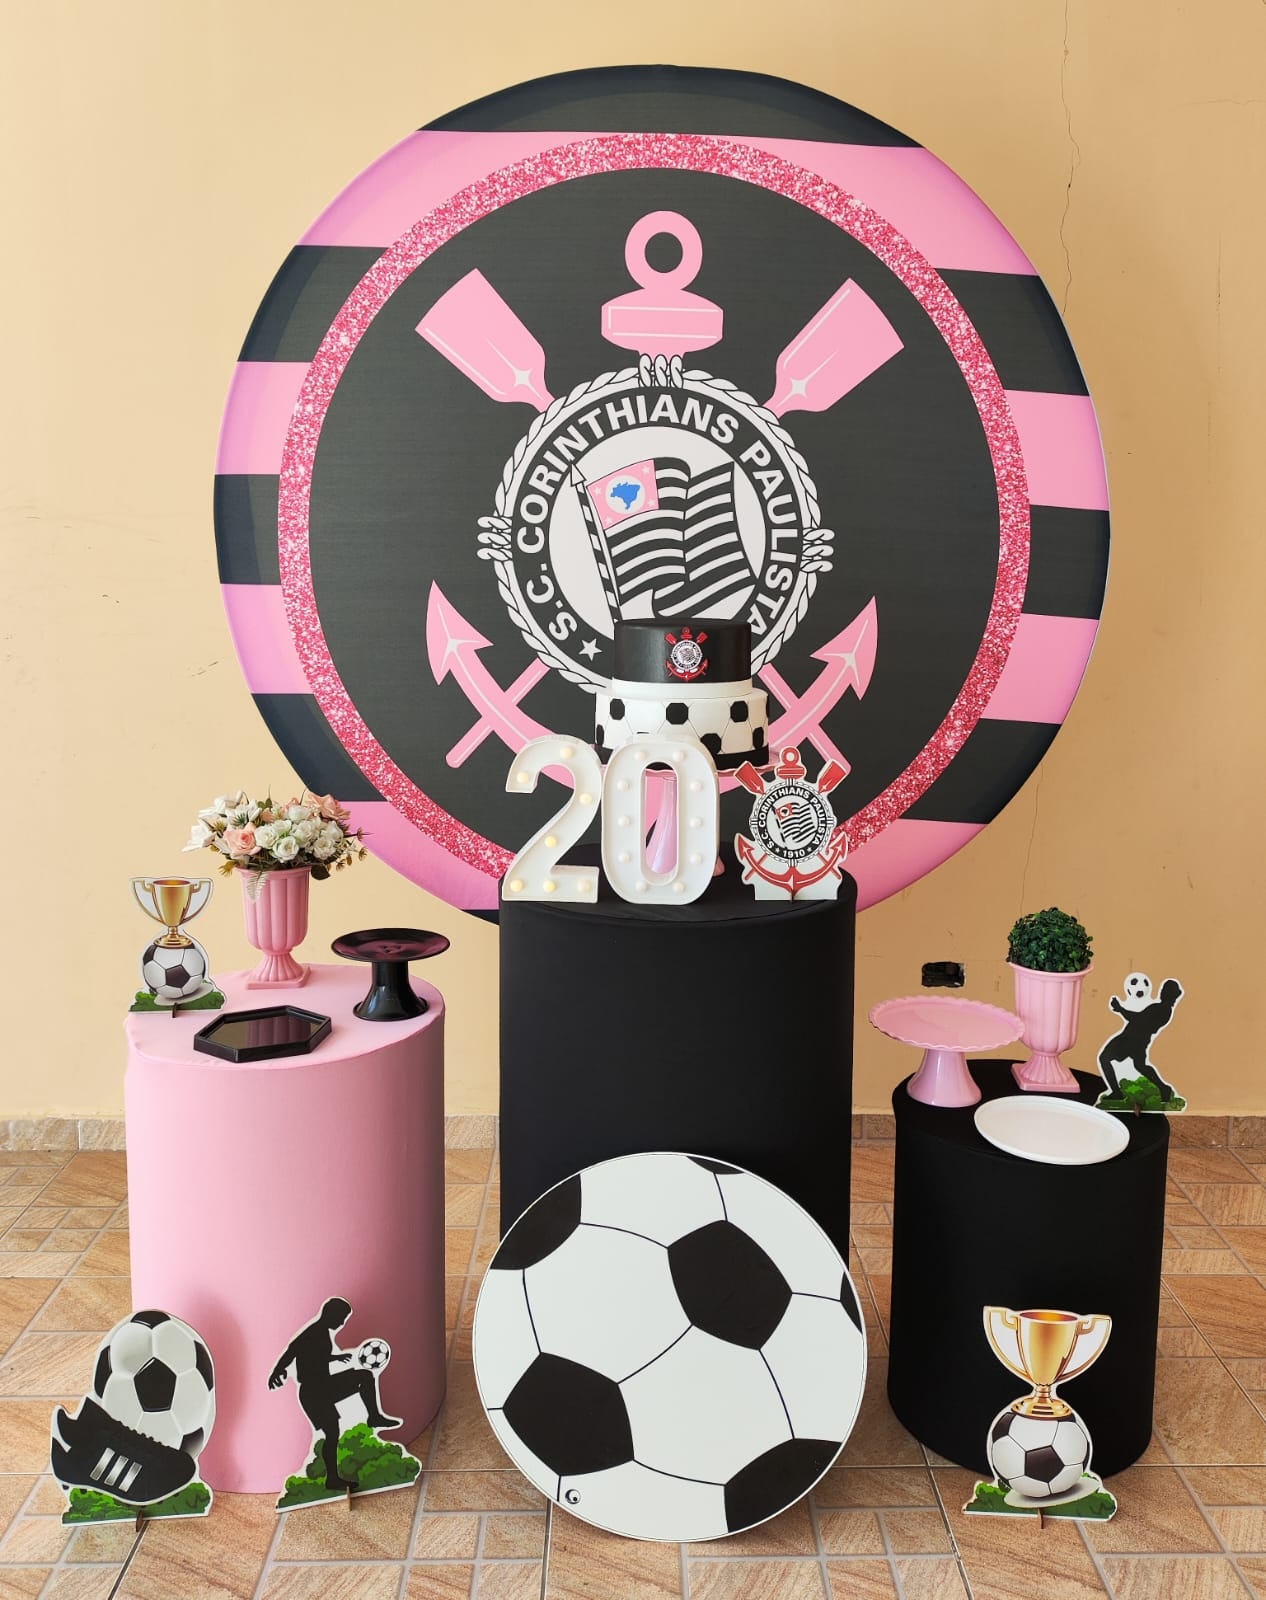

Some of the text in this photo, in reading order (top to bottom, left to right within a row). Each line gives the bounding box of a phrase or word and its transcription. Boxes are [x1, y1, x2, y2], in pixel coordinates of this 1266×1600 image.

[516, 394, 739, 554] CORINTHIANS
[739, 439, 798, 636] PAULISTA
[502, 734, 720, 905] 20
[758, 786, 810, 828] CORINTHIANS
[810, 797, 826, 845] PAULISTA
[783, 849, 805, 859] 1910
